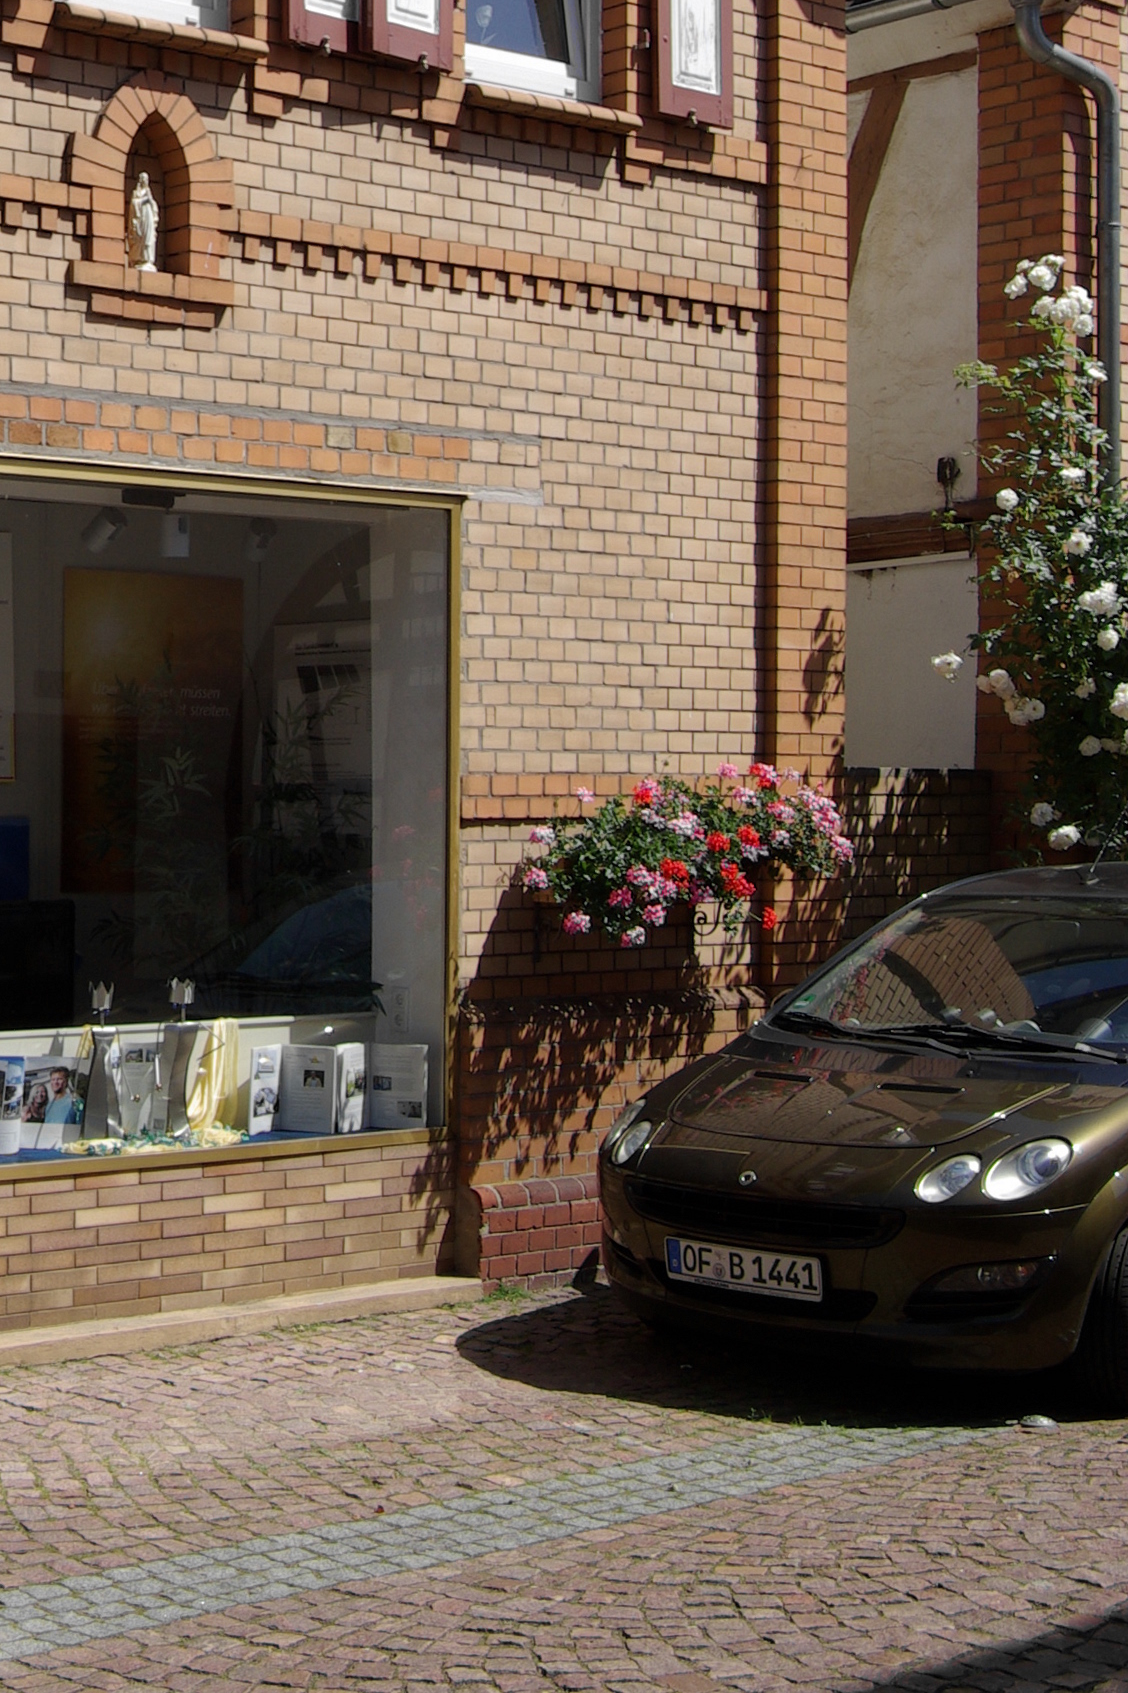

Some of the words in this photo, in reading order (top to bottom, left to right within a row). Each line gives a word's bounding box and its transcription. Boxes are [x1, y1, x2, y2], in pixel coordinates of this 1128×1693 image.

[180, 685, 221, 700] müssen
[683, 1244, 713, 1273] OF
[728, 1252, 745, 1280] B
[751, 1255, 818, 1291] 1441
